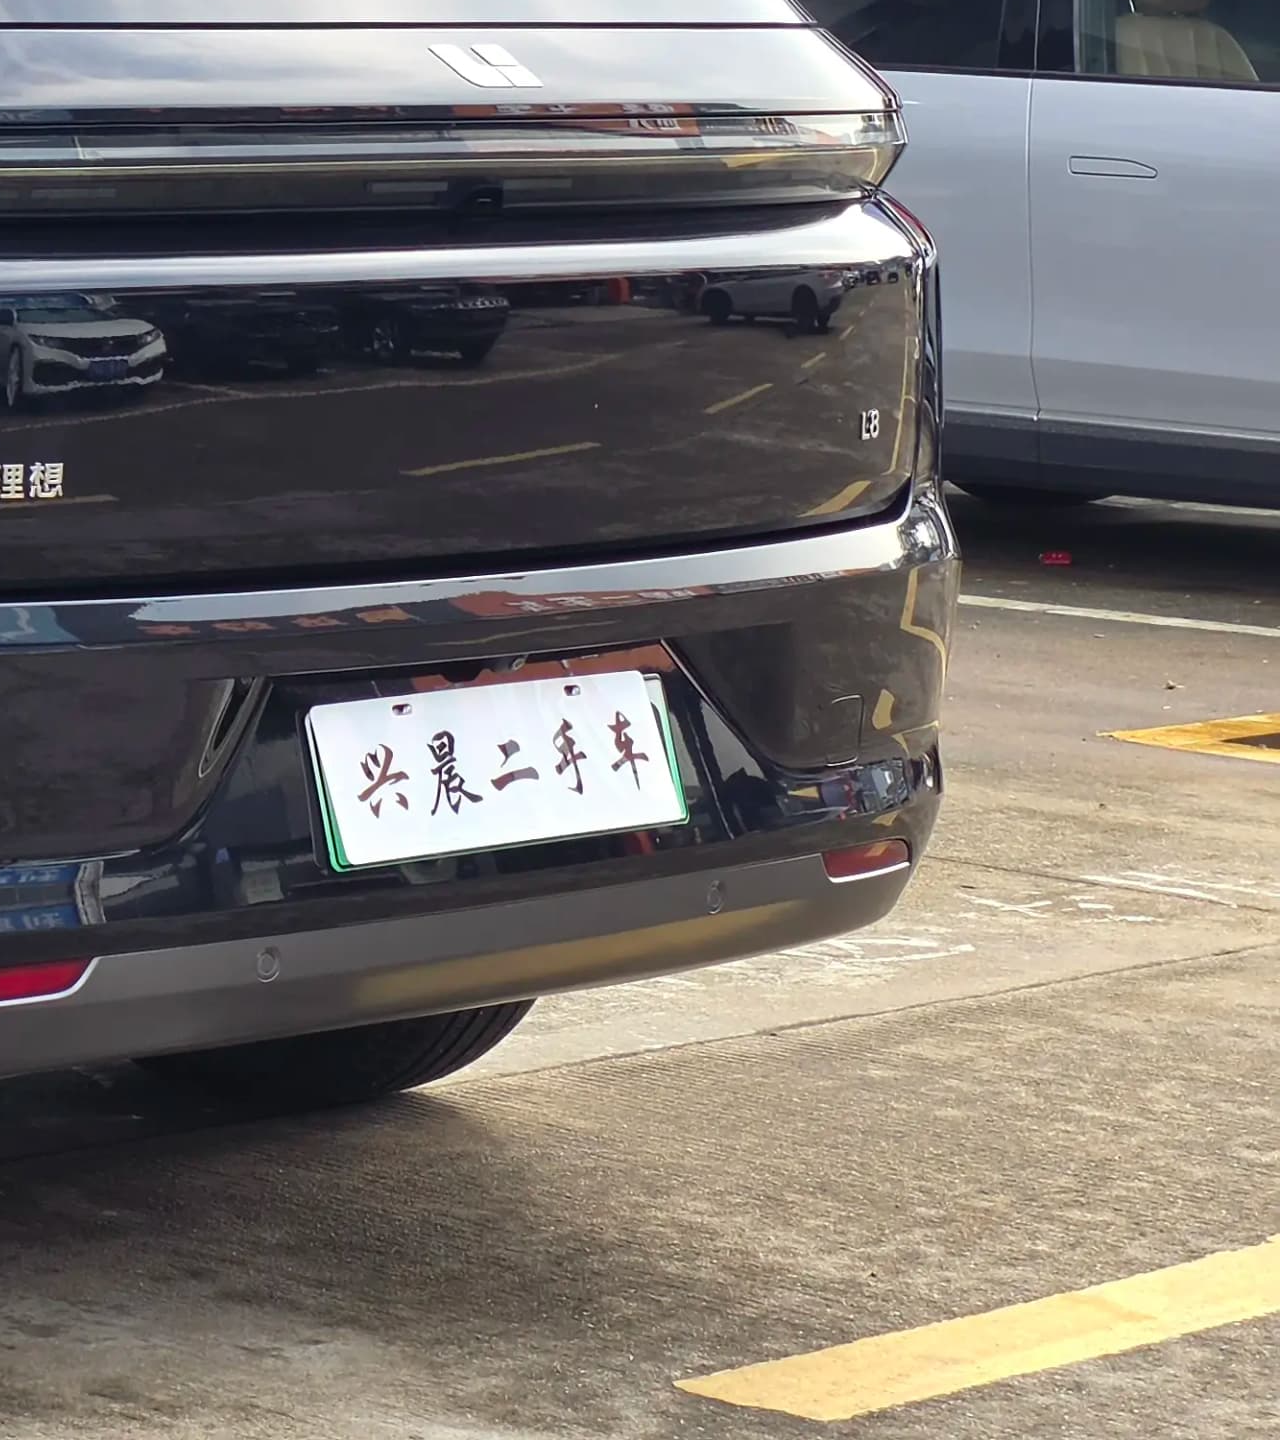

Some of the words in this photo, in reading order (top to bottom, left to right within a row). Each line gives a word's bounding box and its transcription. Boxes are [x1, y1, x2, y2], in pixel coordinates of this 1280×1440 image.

[861, 408, 880, 440] L8
[357, 710, 650, 817] 兴晨二手车
